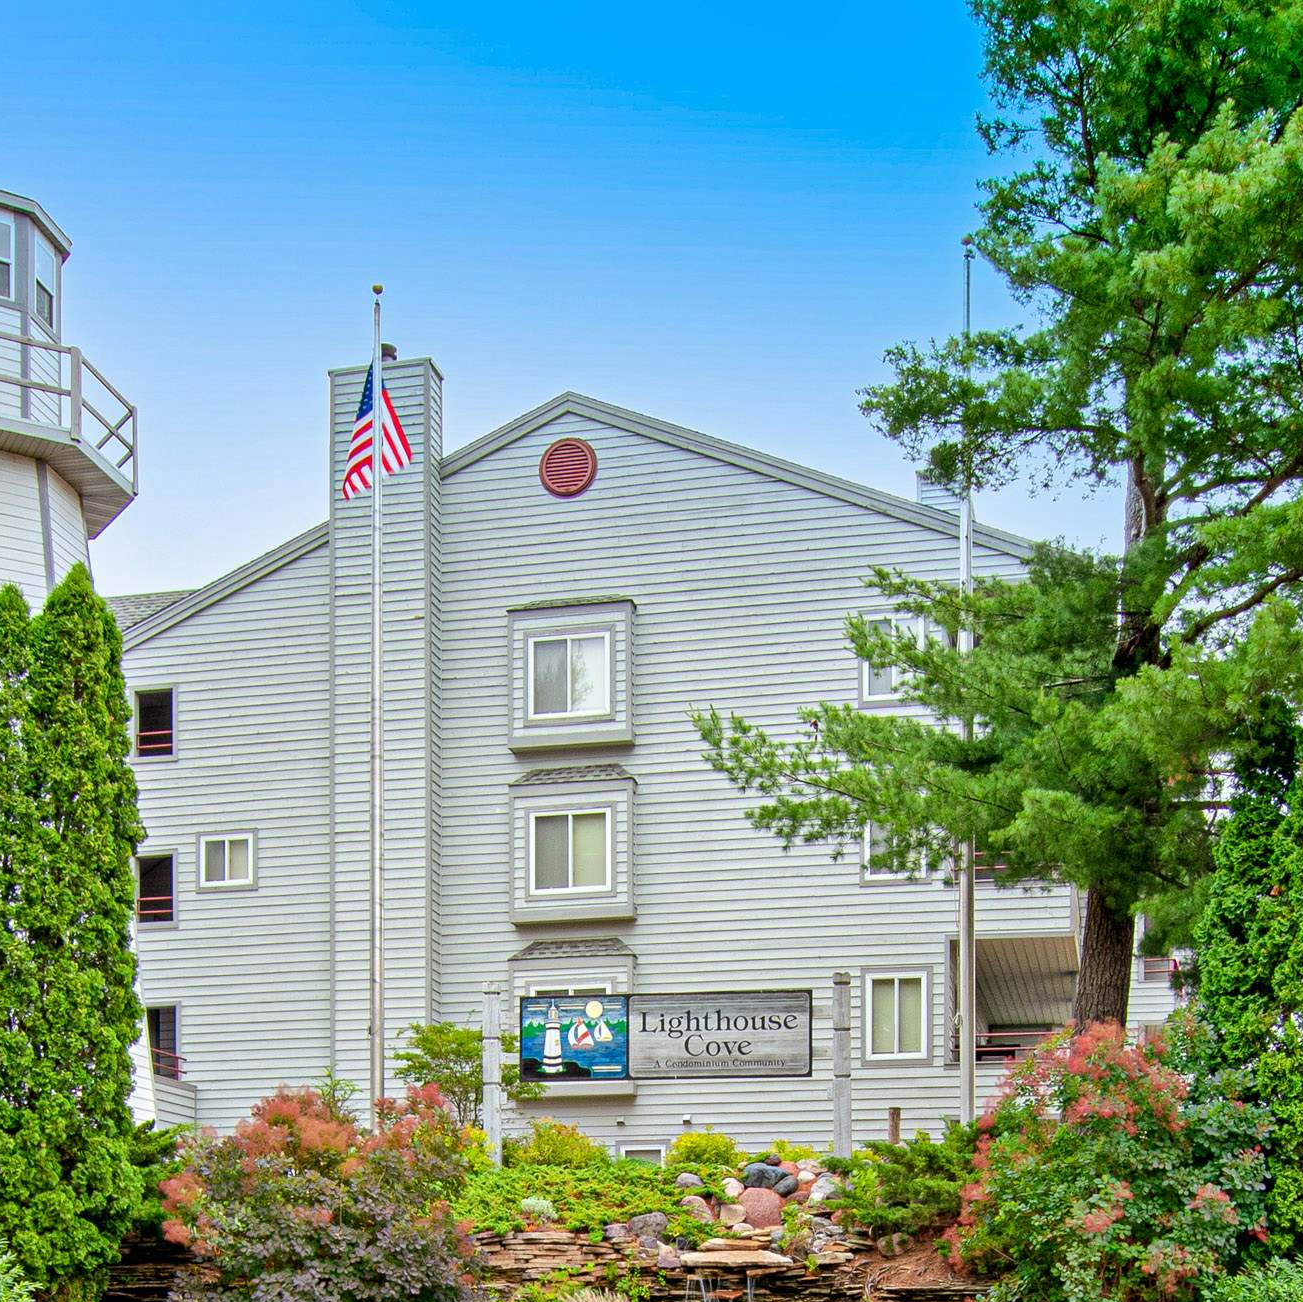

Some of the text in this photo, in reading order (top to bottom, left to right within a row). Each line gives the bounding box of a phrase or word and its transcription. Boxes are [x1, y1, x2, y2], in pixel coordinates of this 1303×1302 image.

[639, 1009, 799, 1039] Lighthouse
[684, 1034, 754, 1057] Cove
[653, 1058, 787, 1069] A Condominium Community
